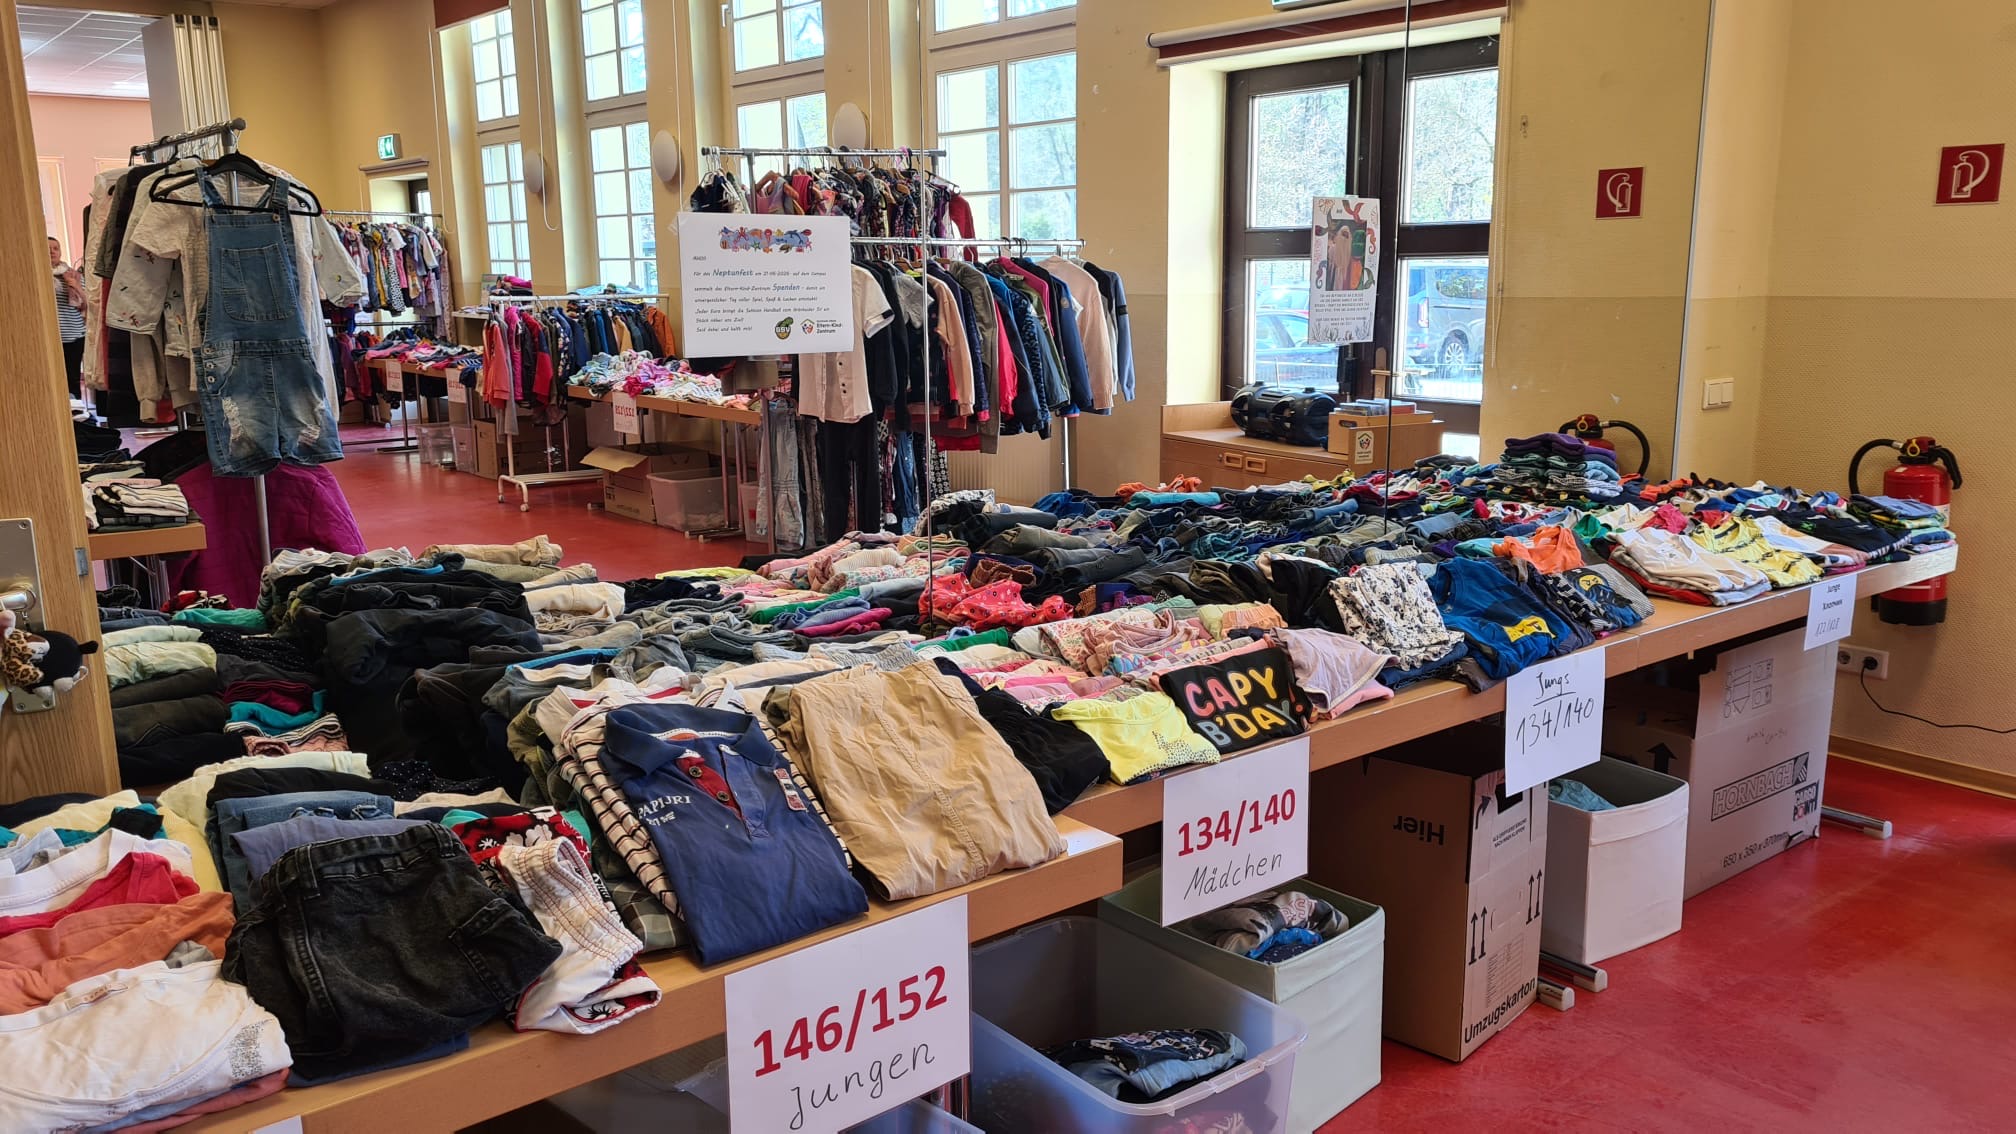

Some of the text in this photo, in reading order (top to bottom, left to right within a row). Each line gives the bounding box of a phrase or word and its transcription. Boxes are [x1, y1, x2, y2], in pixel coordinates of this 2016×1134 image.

[712, 268, 753, 277] Neptunfest
[772, 283, 800, 292] Spenden
[1185, 667, 1278, 717] CAPY
[1535, 672, 1570, 699] Jungs
[1197, 700, 1297, 746] B'DAY
[1516, 697, 1594, 755] 134/140
[1713, 763, 1793, 816] HORNBACH
[1178, 788, 1296, 857] 134/140
[1393, 815, 1444, 845] Hier
[1184, 853, 1282, 900] Mädchen
[753, 965, 947, 1077] 146/152
[1464, 977, 1536, 1043] Umzugskarton
